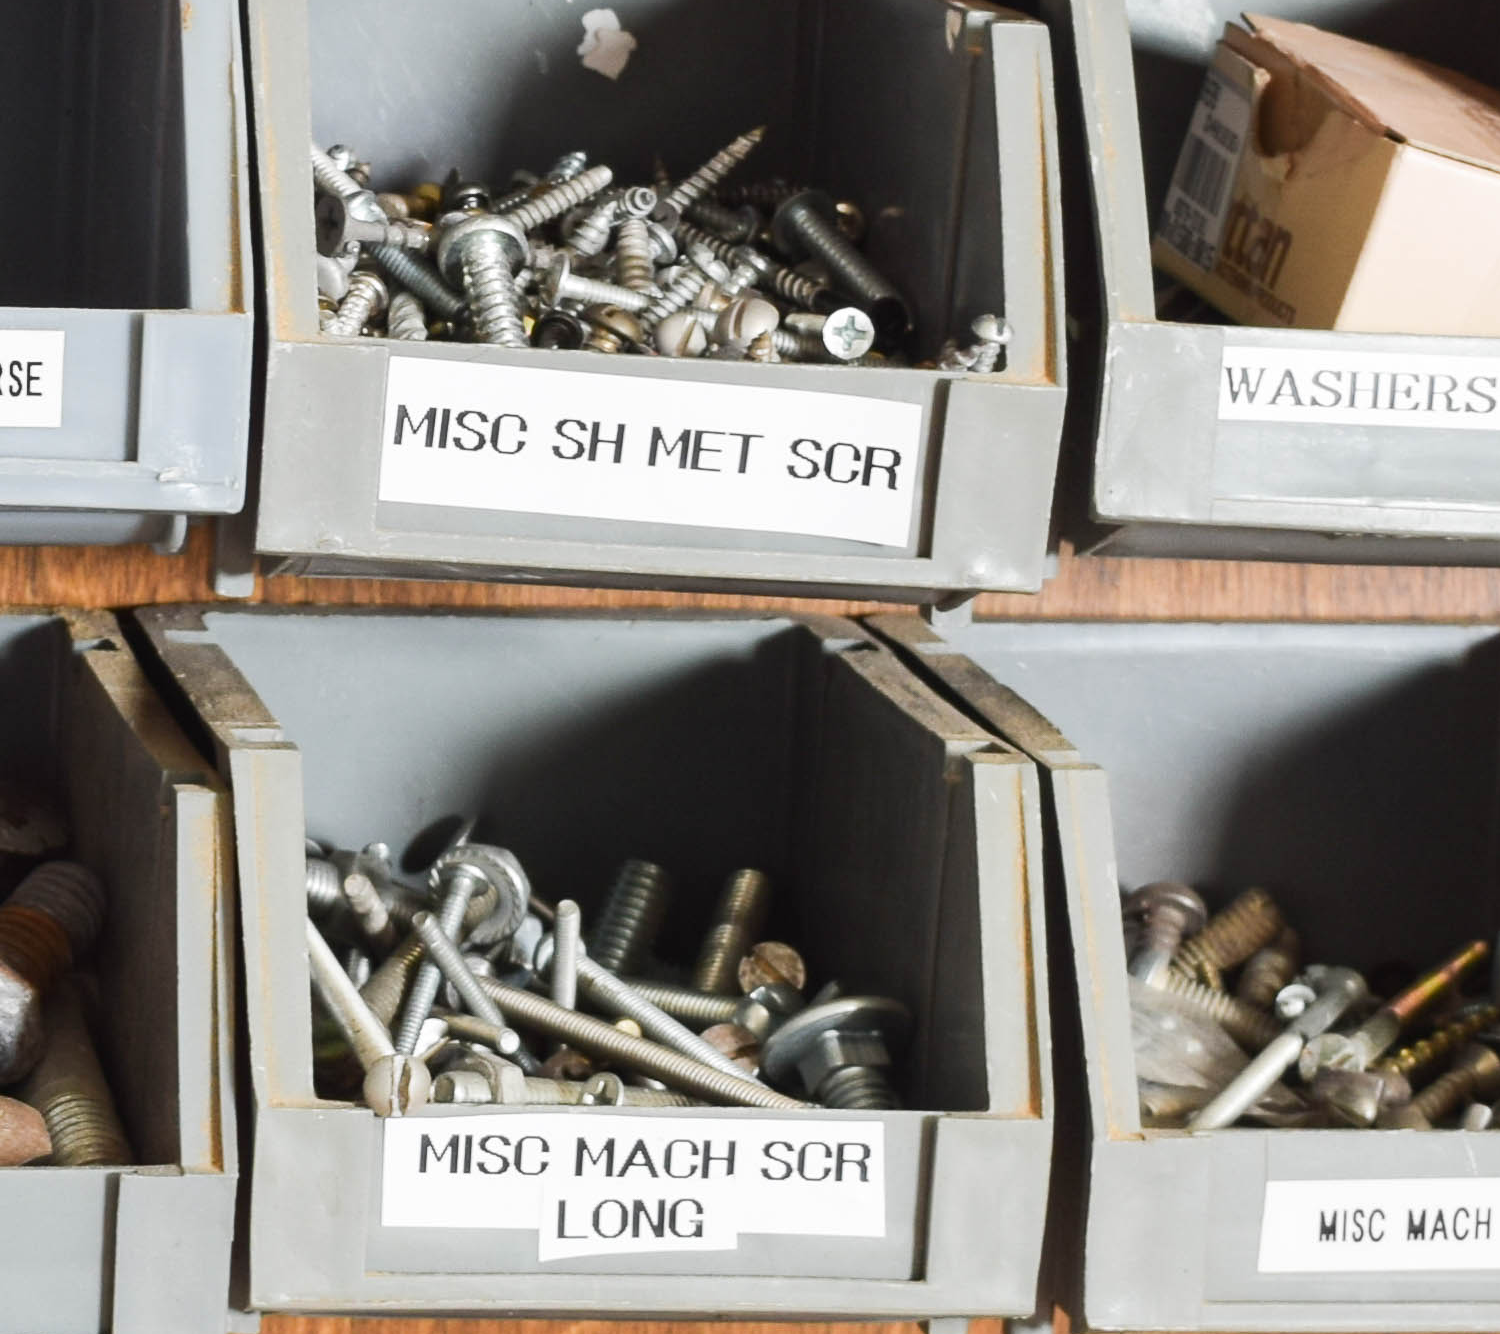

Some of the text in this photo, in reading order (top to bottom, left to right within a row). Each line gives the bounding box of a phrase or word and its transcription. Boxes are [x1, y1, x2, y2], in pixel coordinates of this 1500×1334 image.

[1223, 366, 1497, 414] WASHERS
[393, 404, 902, 491] MISC SH MET SCR
[418, 1133, 872, 1183] MISC MACH SCR
[556, 1198, 704, 1239] LONG
[1318, 1208, 1386, 1243] MISC
[1406, 1207, 1492, 1241] MACH
